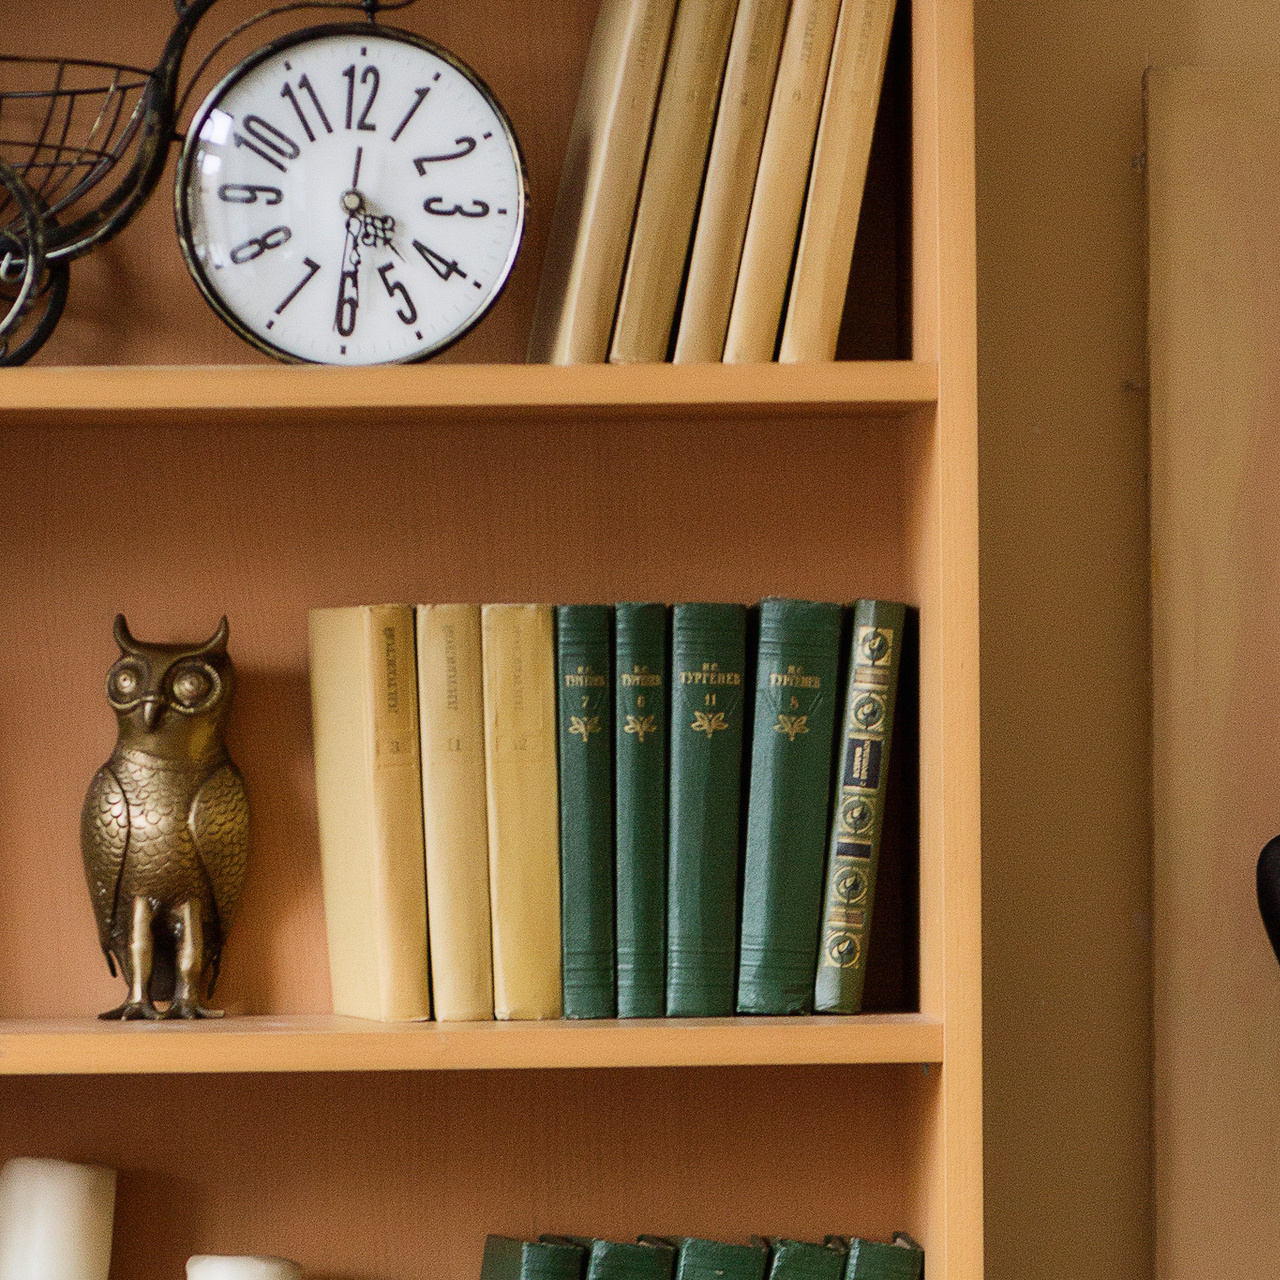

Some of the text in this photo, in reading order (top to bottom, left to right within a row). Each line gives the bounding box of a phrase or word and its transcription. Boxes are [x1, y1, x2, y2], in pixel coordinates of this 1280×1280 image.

[281, 73, 333, 142] 11
[342, 64, 380, 131] 12
[391, 87, 431, 142] 1
[233, 114, 301, 173] 10
[413, 137, 477, 176] 2
[218, 184, 283, 205] 9
[423, 197, 490, 218] 3
[230, 226, 292, 265] 8
[412, 239, 467, 281] 4
[275, 257, 321, 315] 7
[335, 271, 359, 337] 6
[378, 262, 417, 325] 5
[680, 672, 741, 685] ТУРГЕНЕВ
[769, 673, 821, 688] ТУРГЕНЕВ
